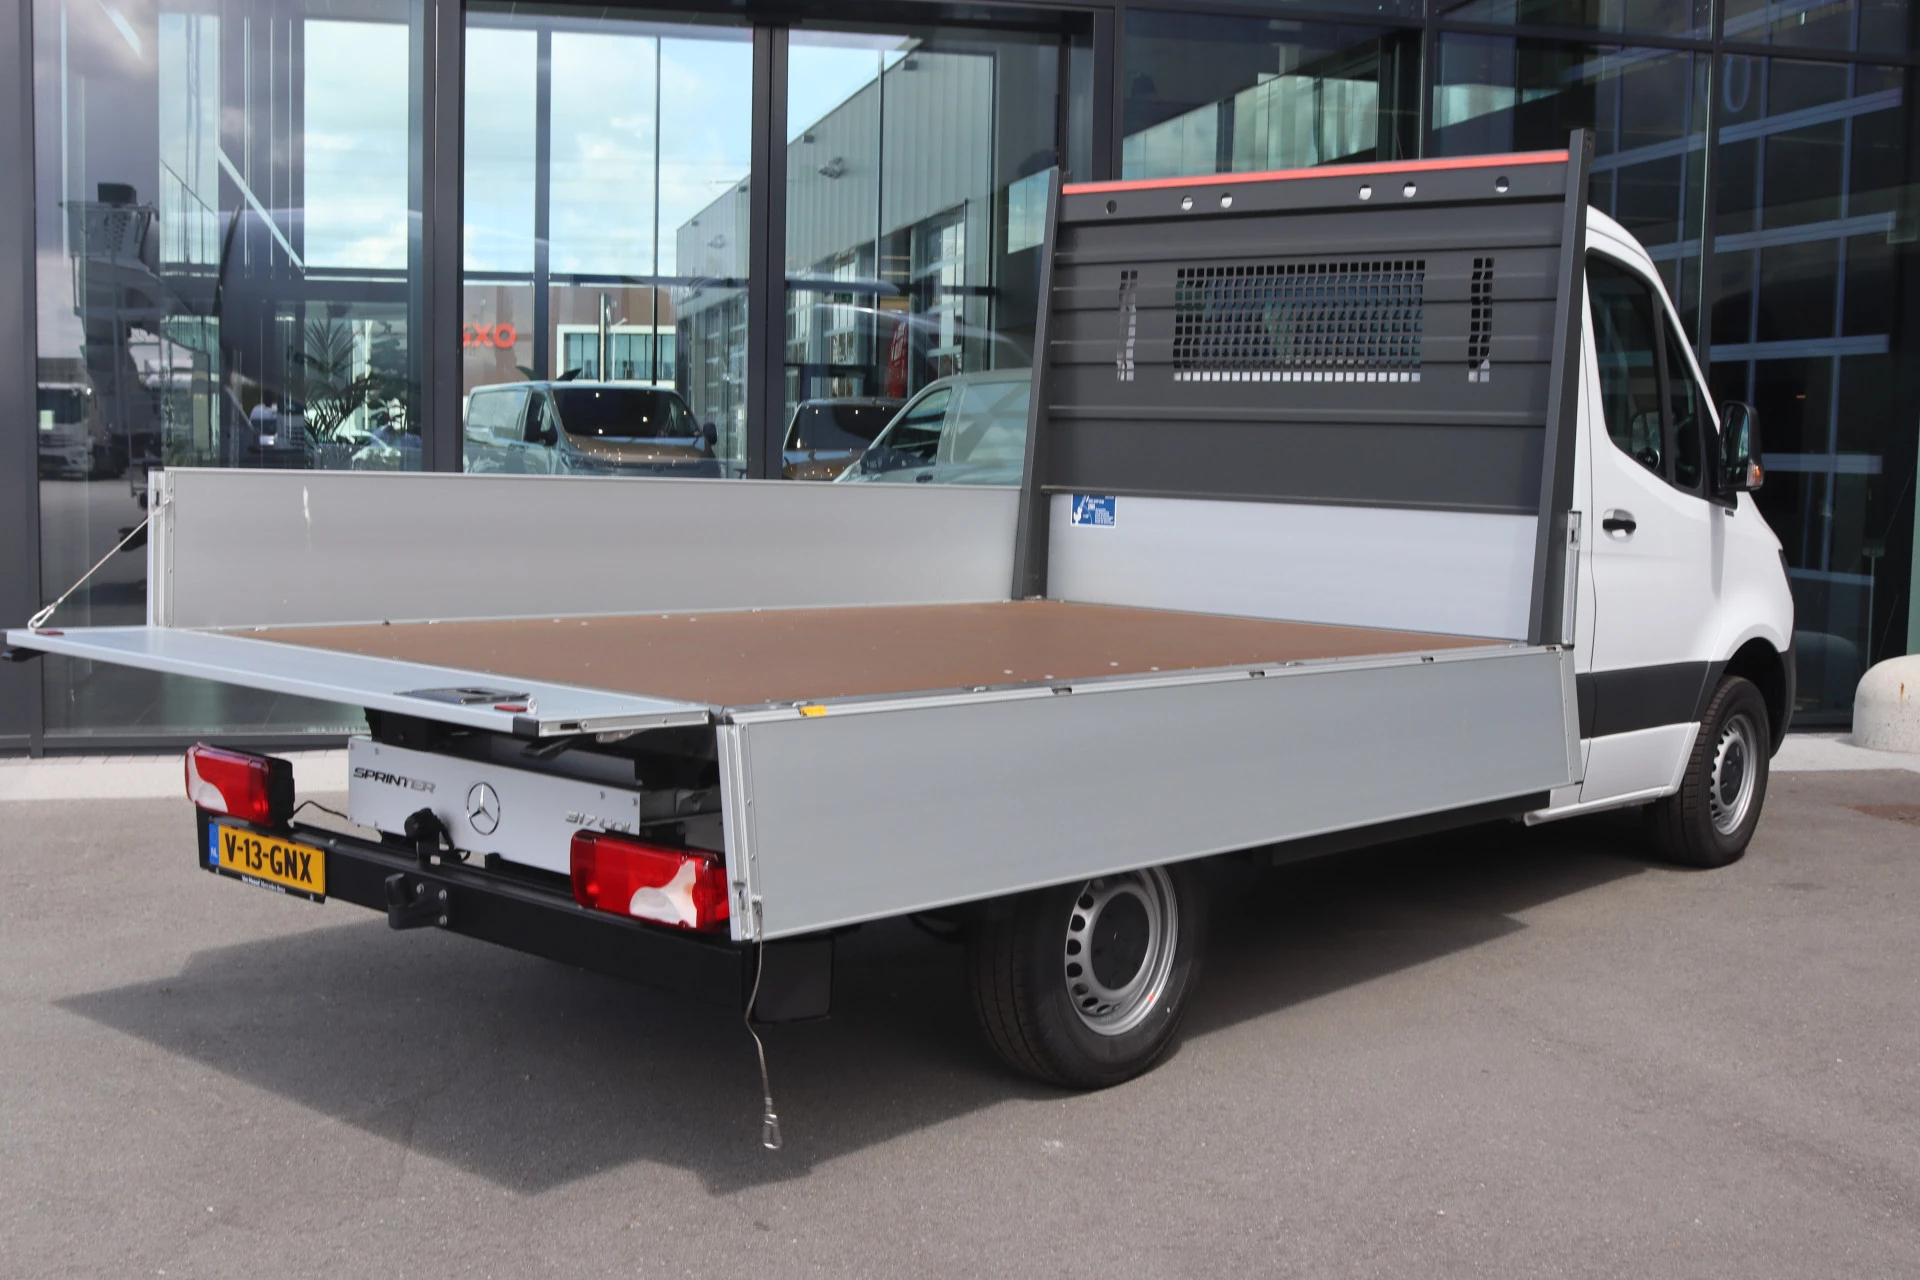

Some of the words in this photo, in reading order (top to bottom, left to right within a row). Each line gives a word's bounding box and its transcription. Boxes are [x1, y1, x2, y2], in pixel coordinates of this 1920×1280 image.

[353, 766, 436, 794] SPRINTER
[566, 810, 597, 827] 317
[225, 832, 312, 884] V-13-GNX
